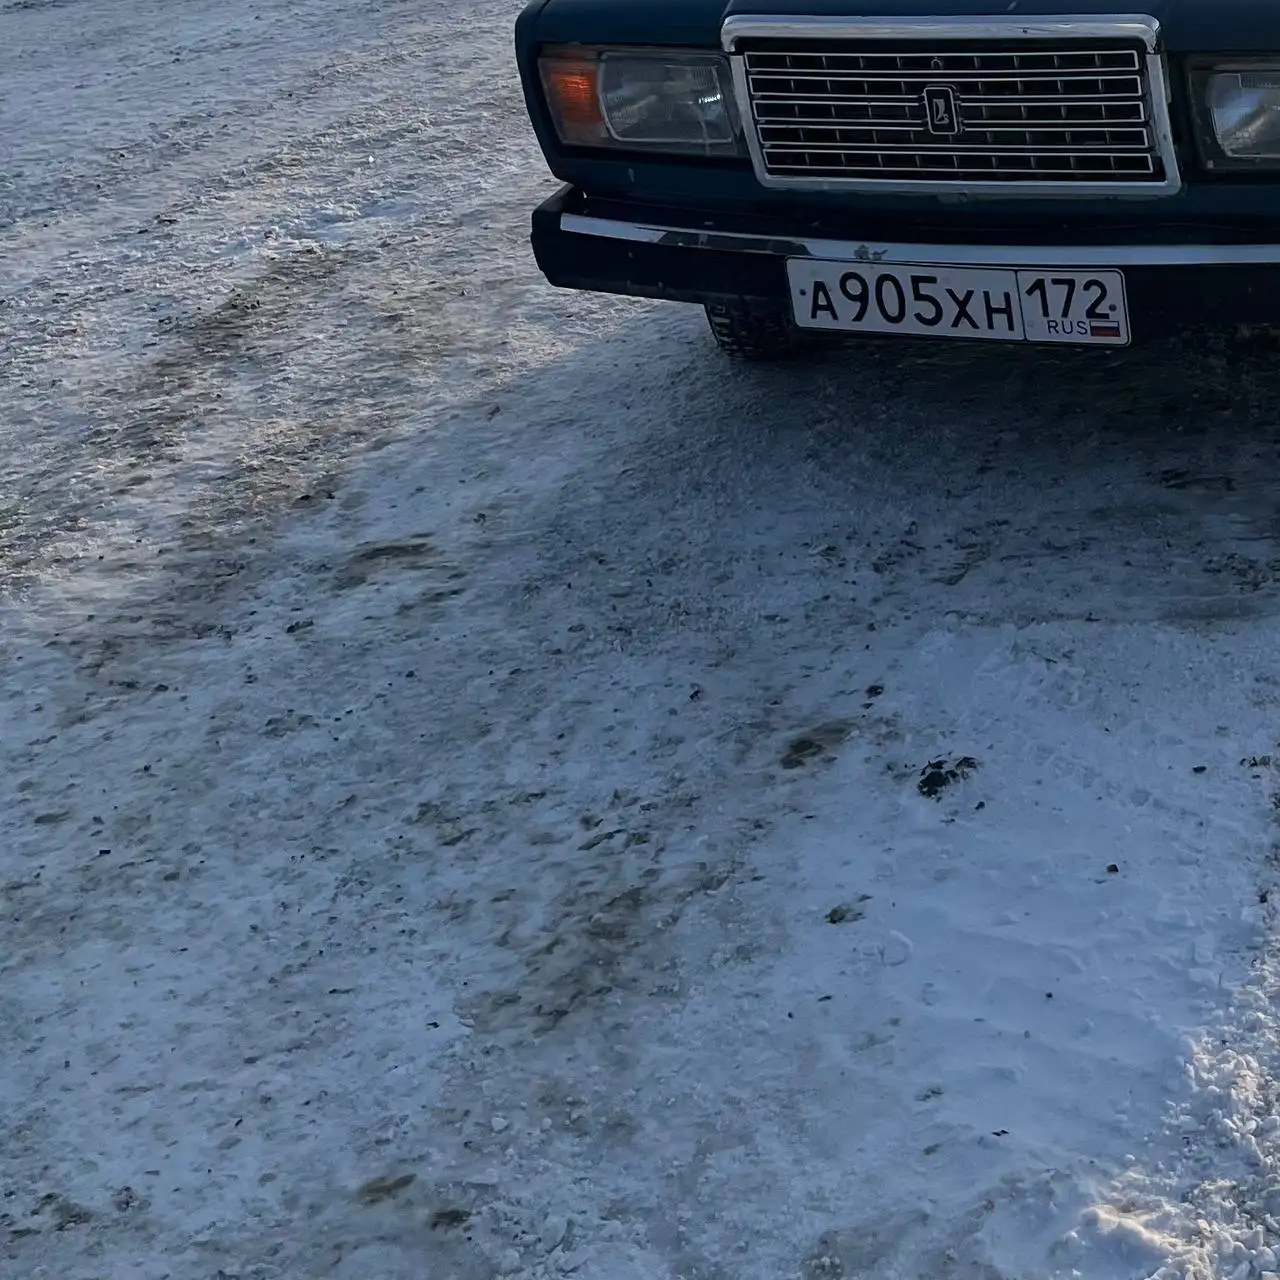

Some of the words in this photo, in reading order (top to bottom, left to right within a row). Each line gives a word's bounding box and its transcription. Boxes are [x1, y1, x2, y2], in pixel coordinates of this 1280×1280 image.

[810, 271, 1016, 332] А905ХН
[1025, 278, 1110, 319] 172
[1047, 319, 1088, 336] RUS
